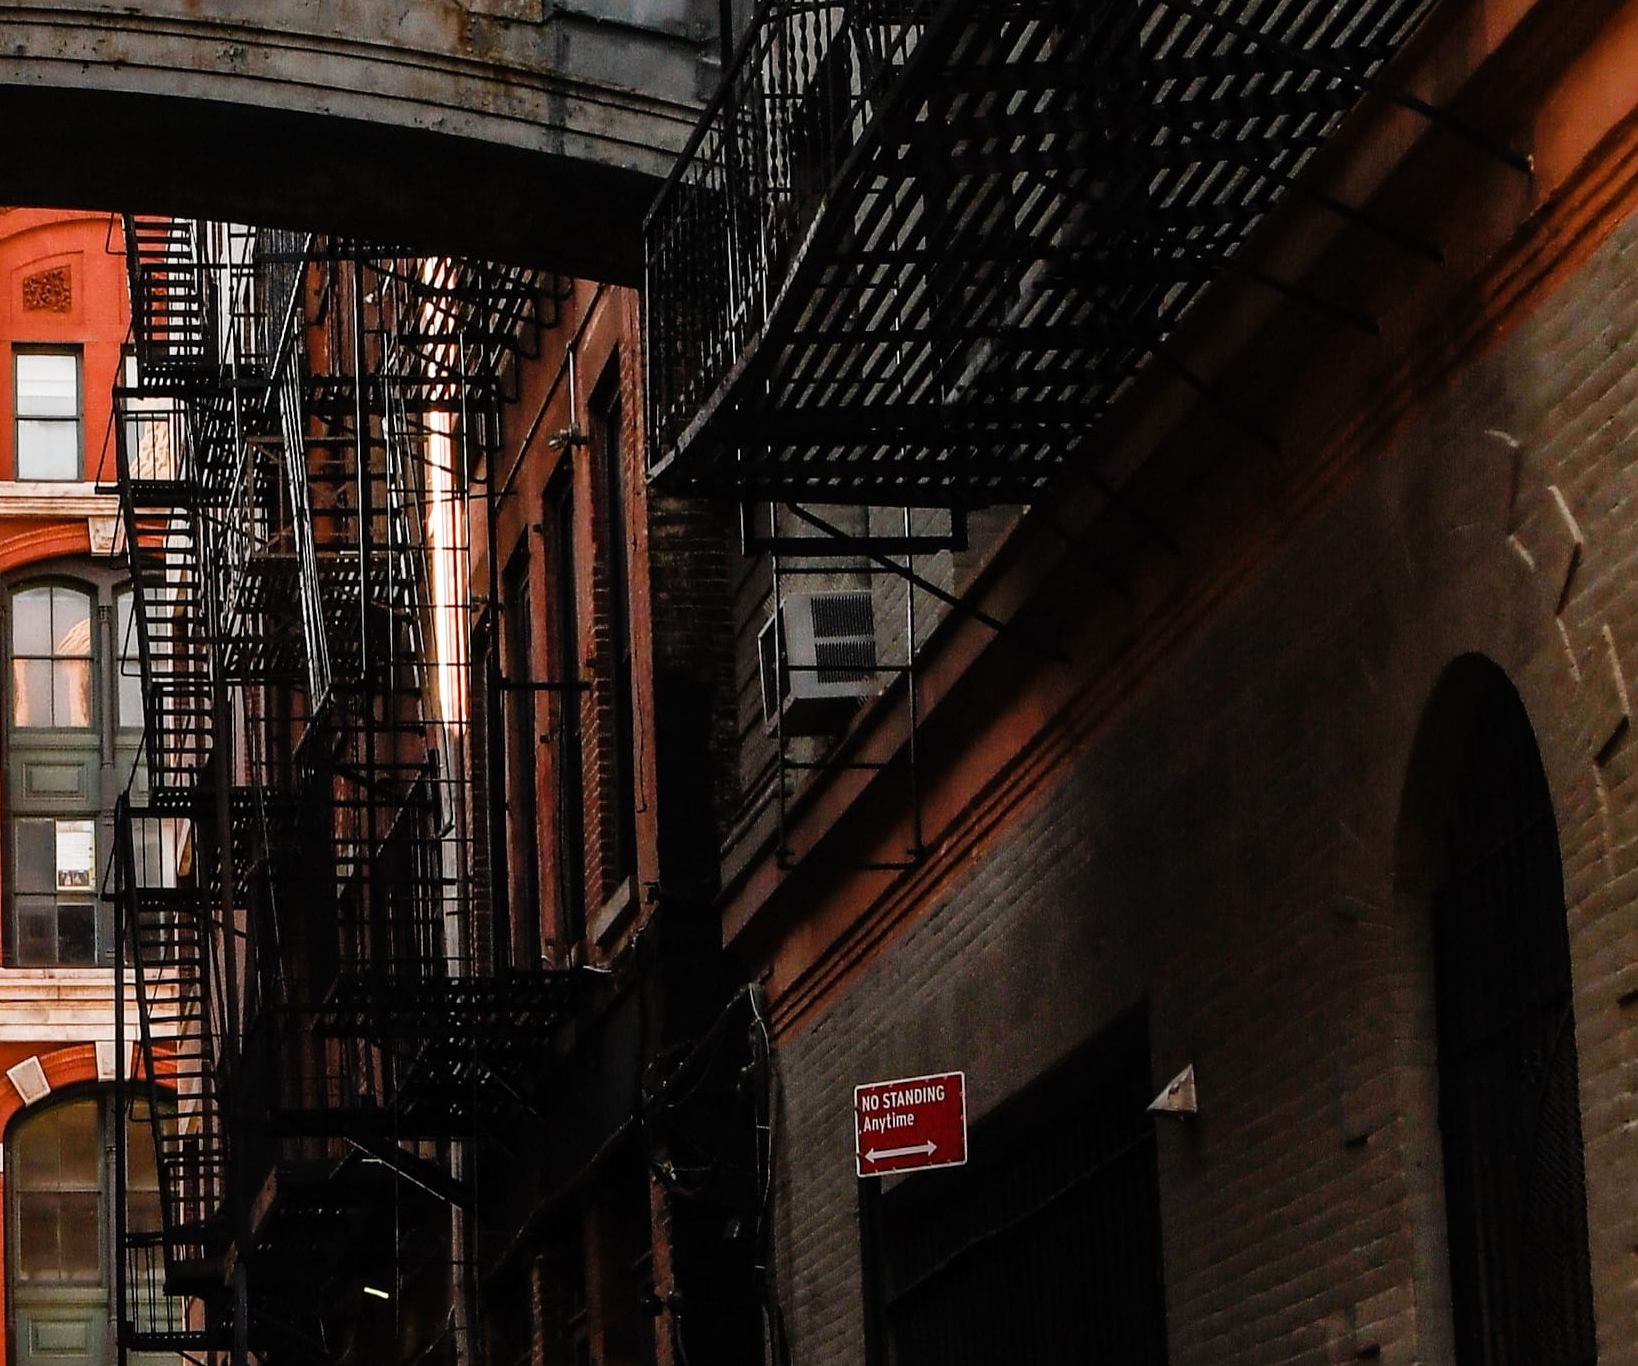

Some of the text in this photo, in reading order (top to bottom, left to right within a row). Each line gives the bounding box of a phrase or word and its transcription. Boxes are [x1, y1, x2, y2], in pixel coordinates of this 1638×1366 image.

[861, 1084, 946, 1112] NO STANDING
[863, 1112, 915, 1134] Anytime
